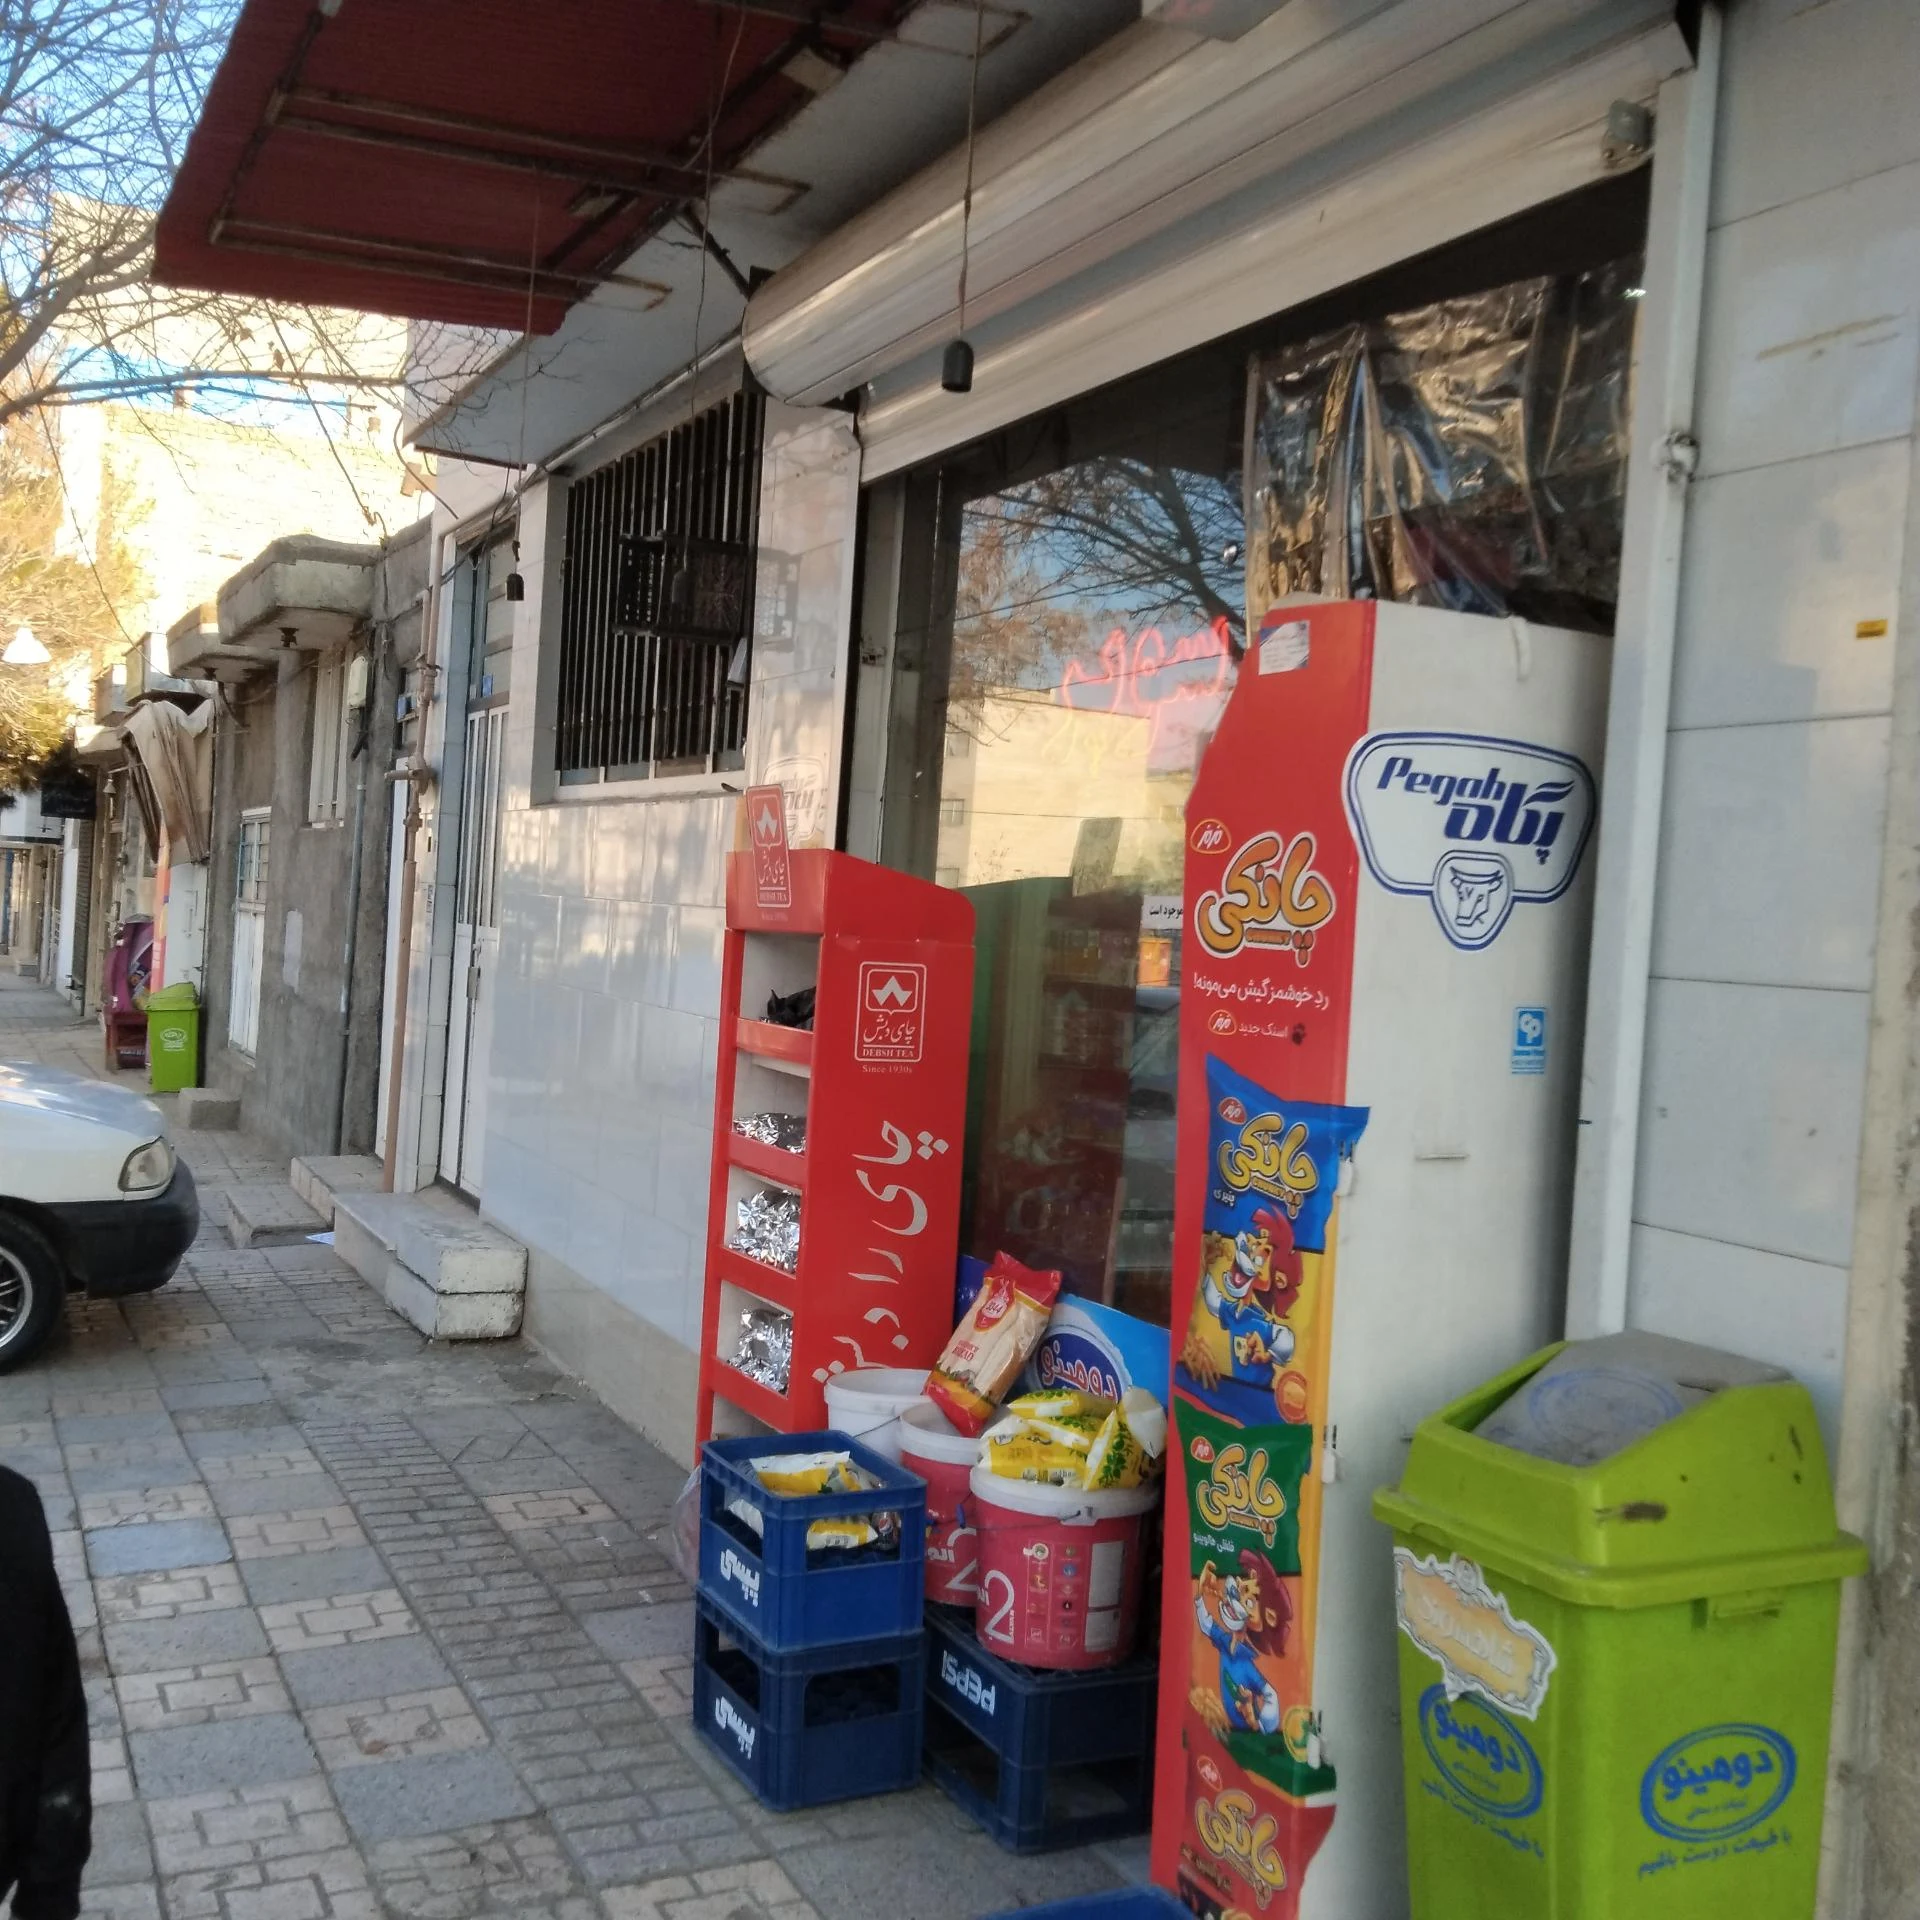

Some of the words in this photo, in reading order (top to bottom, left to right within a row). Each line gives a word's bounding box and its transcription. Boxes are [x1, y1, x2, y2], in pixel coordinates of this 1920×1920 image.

[1377, 757, 1506, 805] Pegah
[1444, 780, 1575, 866] پگاه
[772, 856, 785, 885] چای
[1195, 832, 1335, 967] چانکی
[863, 1014, 890, 1042] دبش
[863, 1048, 893, 1057] DEBSH
[897, 1049, 914, 1057] TEA
[891, 1019, 916, 1044] چای
[862, 1064, 886, 1073] Since
[852, 1120, 949, 1236] چای
[1217, 1112, 1319, 1220] چانکی
[1196, 1443, 1287, 1549] چانکی
[720, 1549, 760, 1608] پپسی
[984, 1569, 1024, 1644] 2
[942, 1650, 996, 1716] PEPSI
[714, 1695, 755, 1759] پپسی
[1432, 1703, 1522, 1773] دومینو
[1662, 1750, 1773, 1802] دومینو
[1195, 1789, 1287, 1910] چانکی
